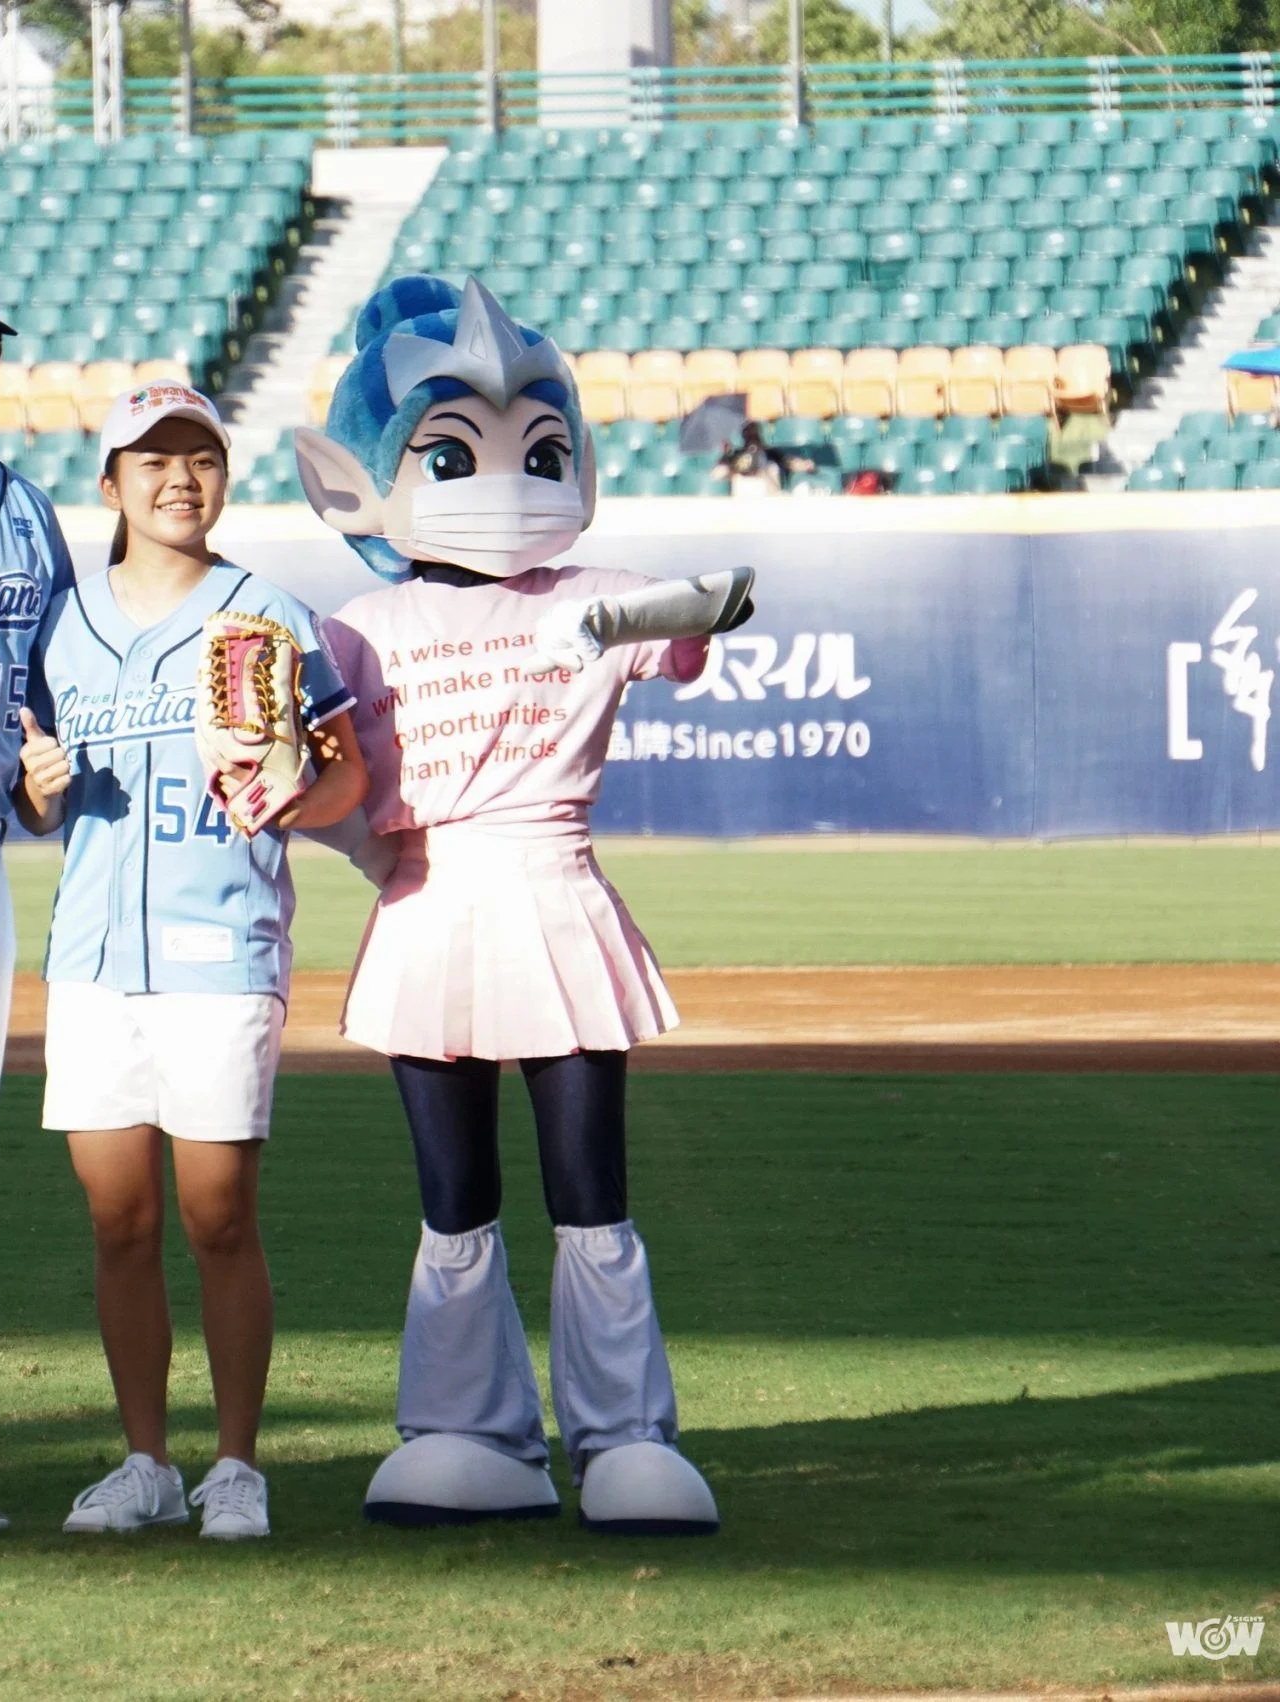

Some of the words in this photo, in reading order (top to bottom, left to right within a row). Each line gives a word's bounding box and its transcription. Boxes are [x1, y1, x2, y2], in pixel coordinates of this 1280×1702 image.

[388, 651, 402, 672] A
[410, 638, 473, 664] wise
[619, 632, 871, 701] スマイル
[418, 670, 492, 700] make
[55, 682, 196, 750] Guardia
[401, 758, 450, 785] han
[493, 737, 558, 763] finds
[154, 776, 233, 846] 54
